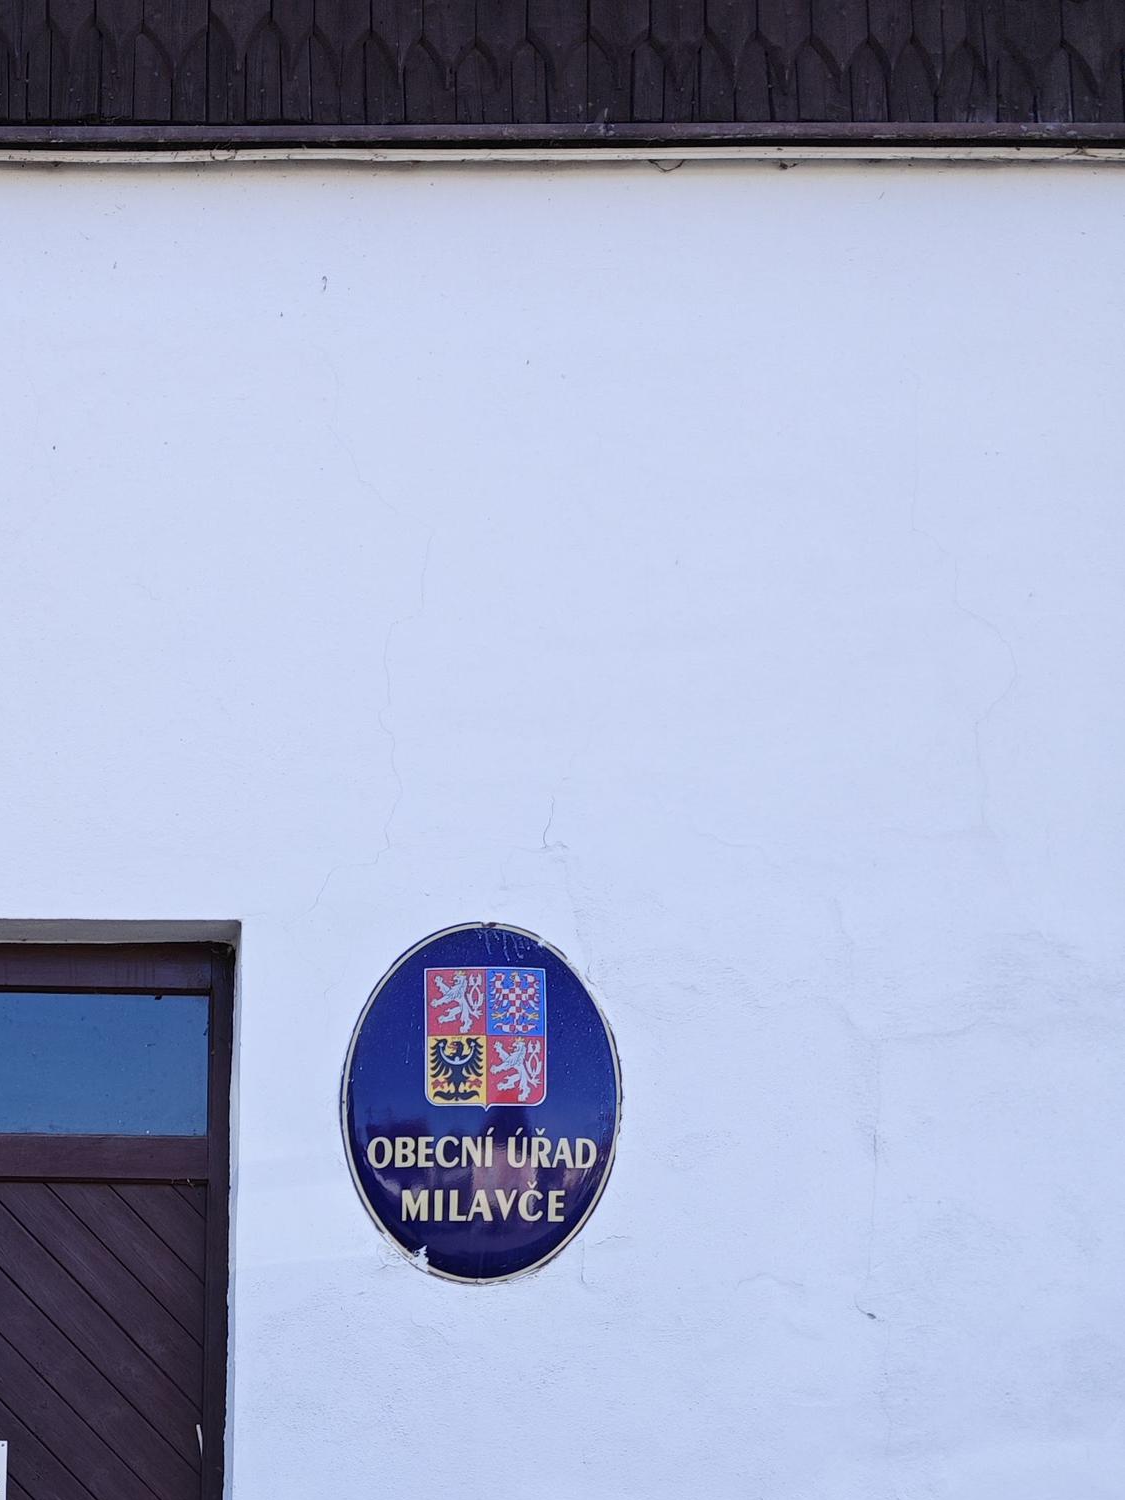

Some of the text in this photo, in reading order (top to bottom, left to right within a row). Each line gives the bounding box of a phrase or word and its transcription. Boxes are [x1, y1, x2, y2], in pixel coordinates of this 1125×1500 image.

[366, 1126, 598, 1169] OBECNÍ ÚŘAD
[401, 1182, 565, 1222] MILAVČE
